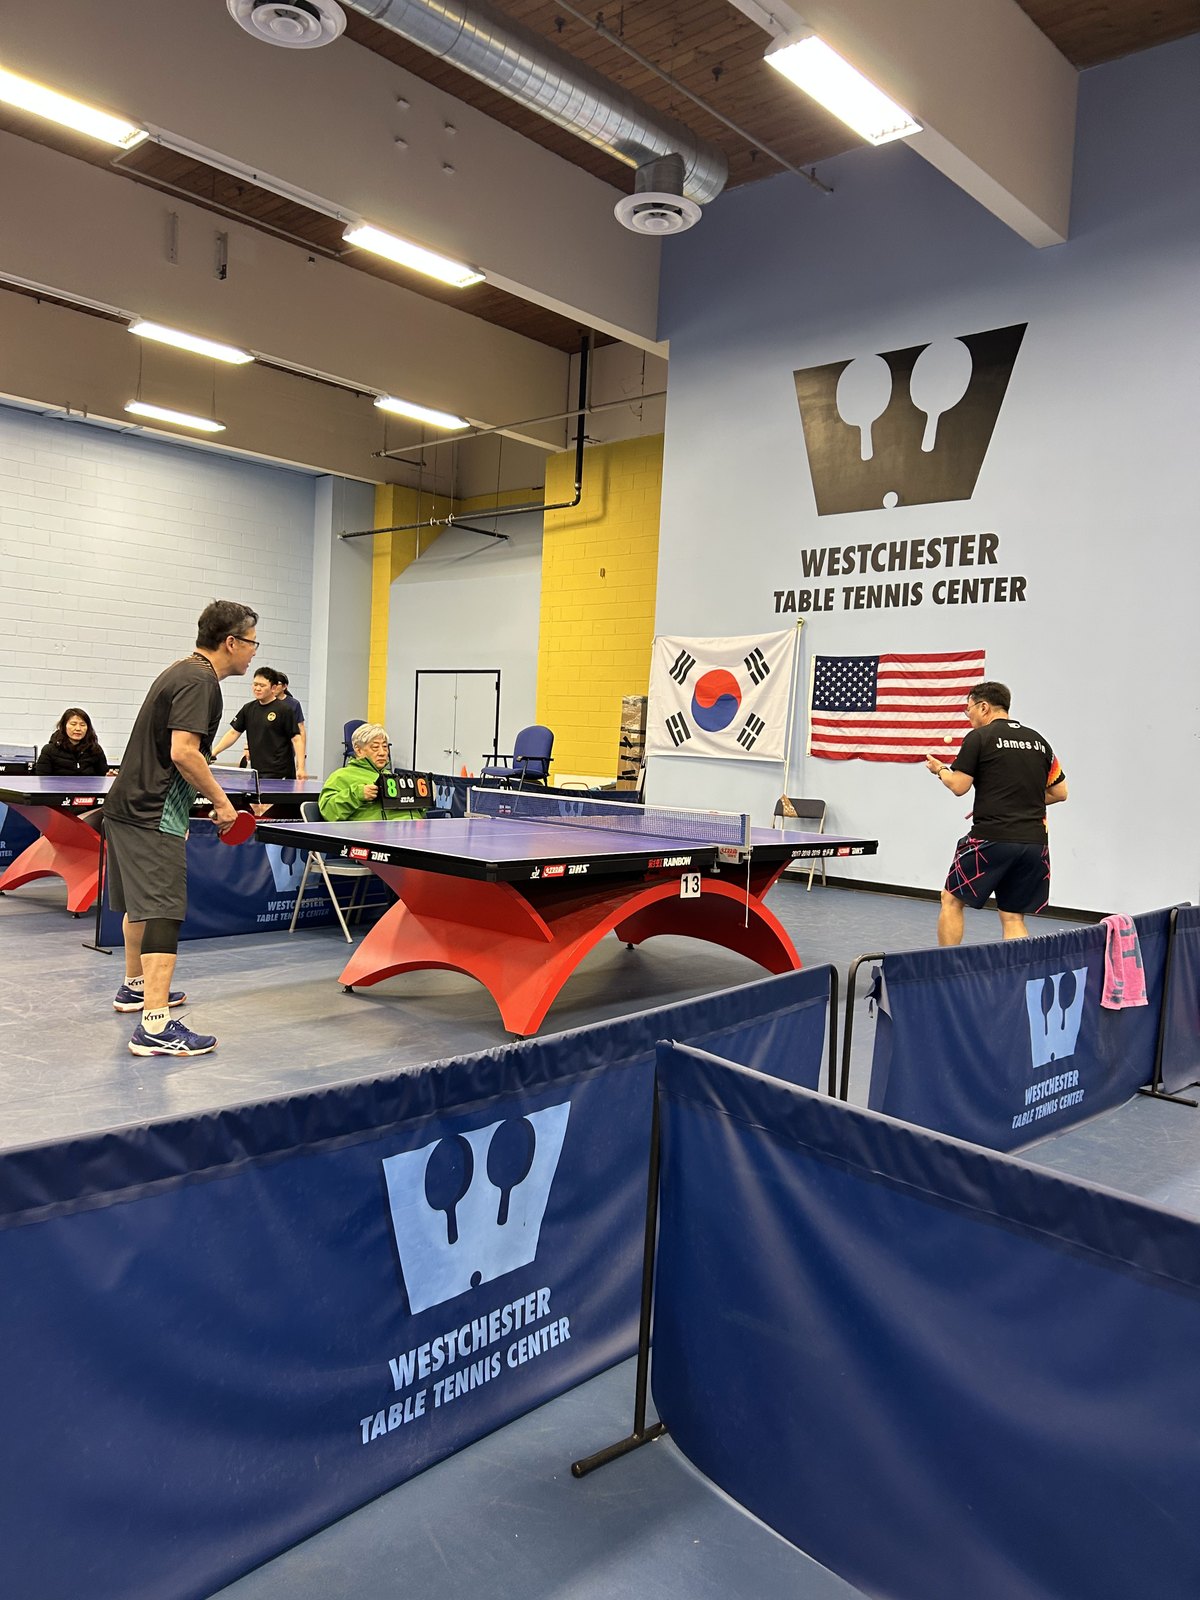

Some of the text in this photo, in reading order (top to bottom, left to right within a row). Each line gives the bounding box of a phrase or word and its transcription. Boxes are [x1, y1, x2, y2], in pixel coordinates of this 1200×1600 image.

[801, 533, 999, 577] WESTCHESTER
[774, 576, 1027, 613] TABLE TENNIS CENTER
[996, 738, 1032, 750] James
[386, 778, 397, 798] 8
[417, 778, 428, 797] 6
[663, 856, 692, 868] RAINBOW
[683, 876, 699, 893] 13
[257, 913, 278, 922] TABLE
[280, 911, 304, 920] TENIS
[268, 898, 324, 911] WESTCESTER
[1025, 1069, 1079, 1105] WESTCHESTER
[1012, 1089, 1084, 1129] TABLE TENNIS CENTER
[389, 1287, 551, 1391] WESTCHESTER
[360, 1316, 571, 1444] TABLE TENNIS CENTER
